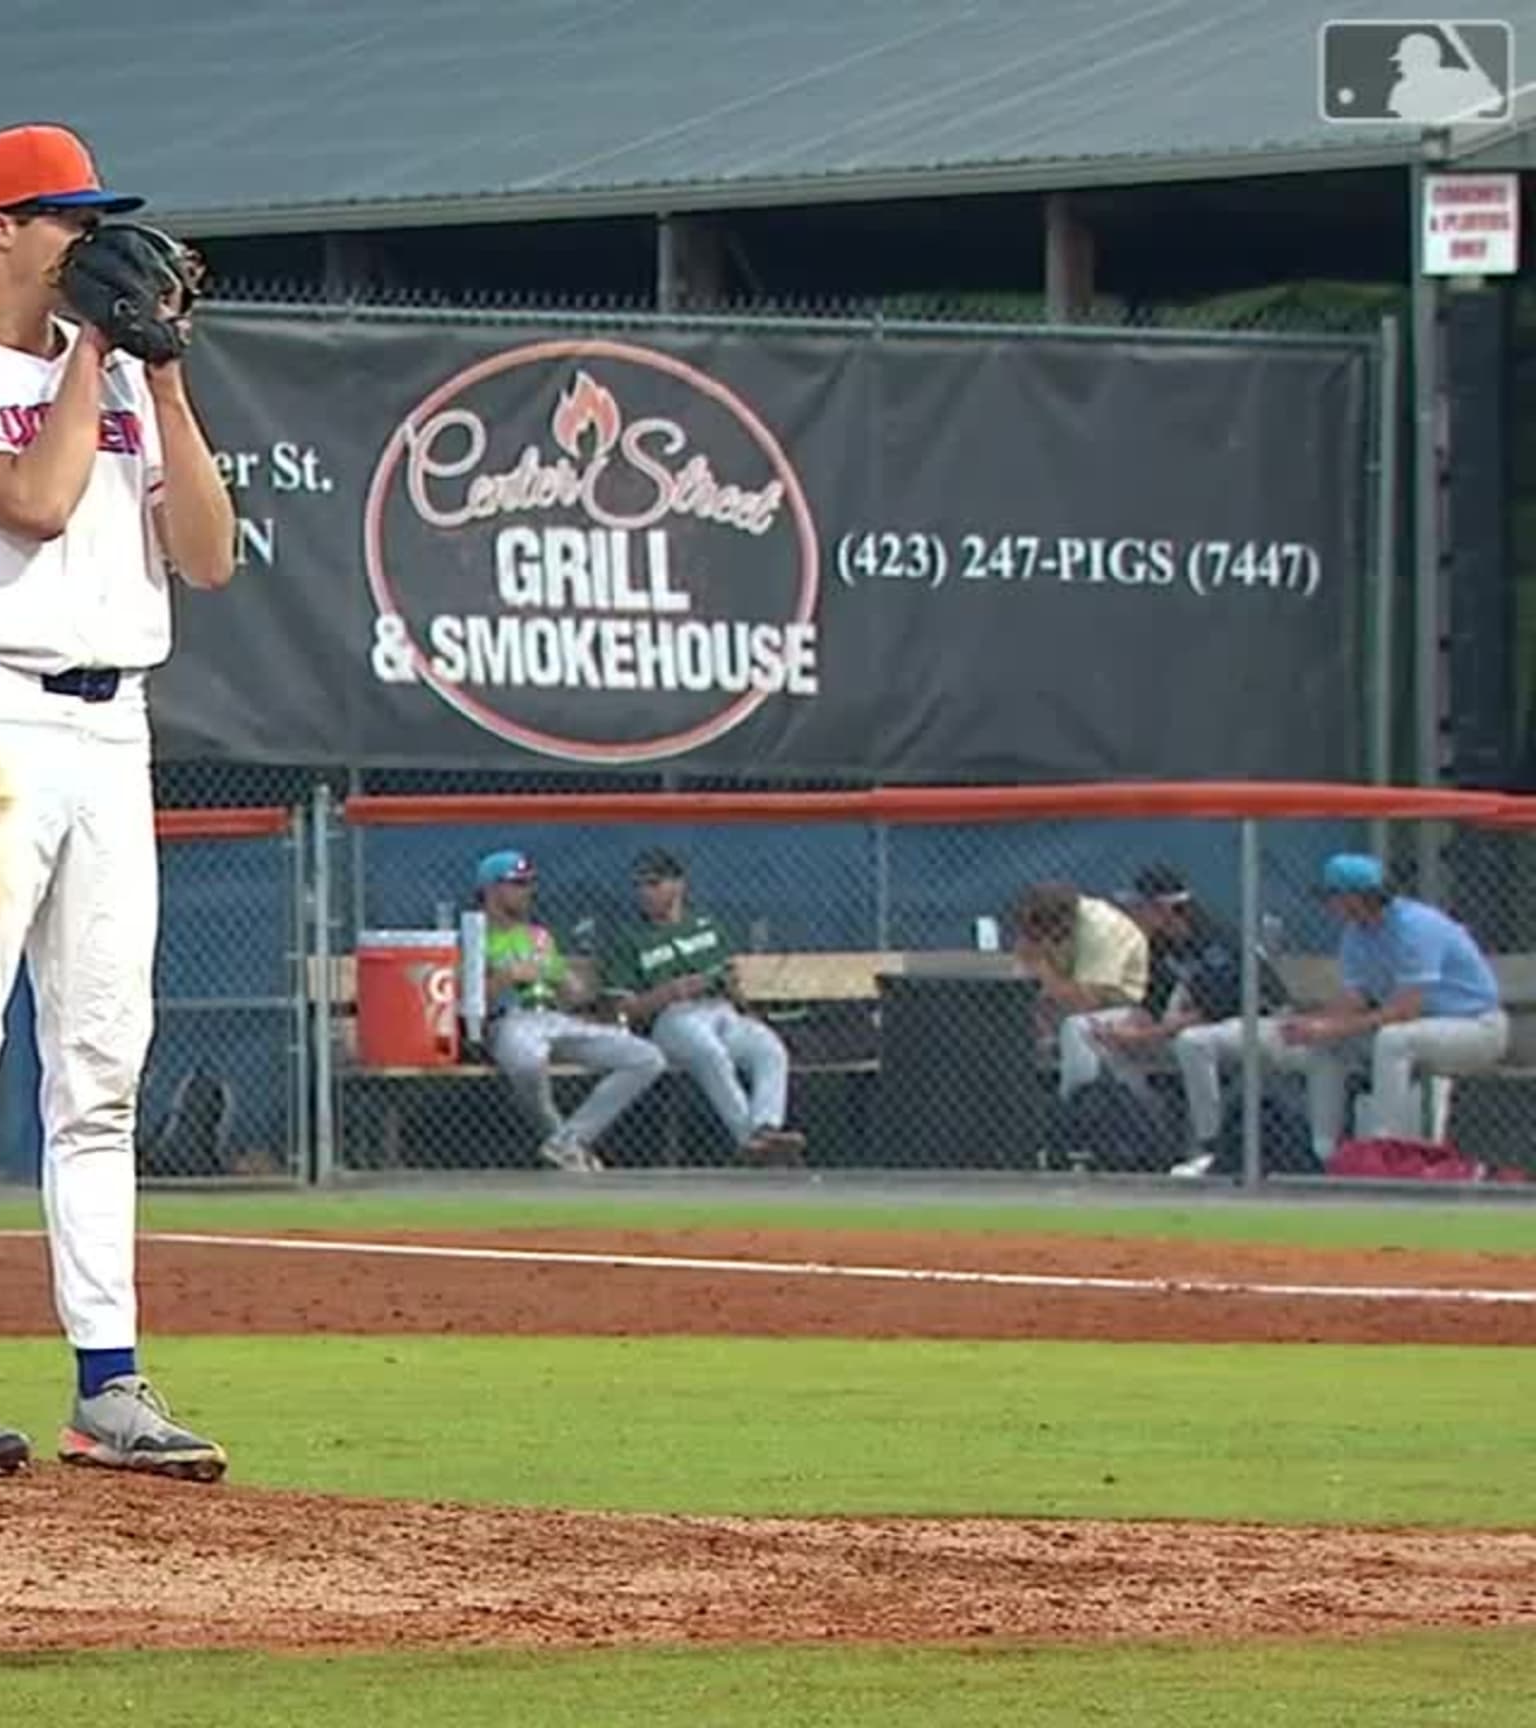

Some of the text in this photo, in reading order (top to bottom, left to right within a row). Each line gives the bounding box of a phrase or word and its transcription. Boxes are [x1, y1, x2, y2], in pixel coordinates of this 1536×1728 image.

[213, 441, 333, 492] er St.
[401, 409, 782, 535] Center Street
[235, 517, 275, 568] N
[495, 526, 691, 612] GRILL
[837, 533, 1322, 596] (423) 247-PIGS (7447)
[371, 613, 819, 695] & SMOKEHOUSE
